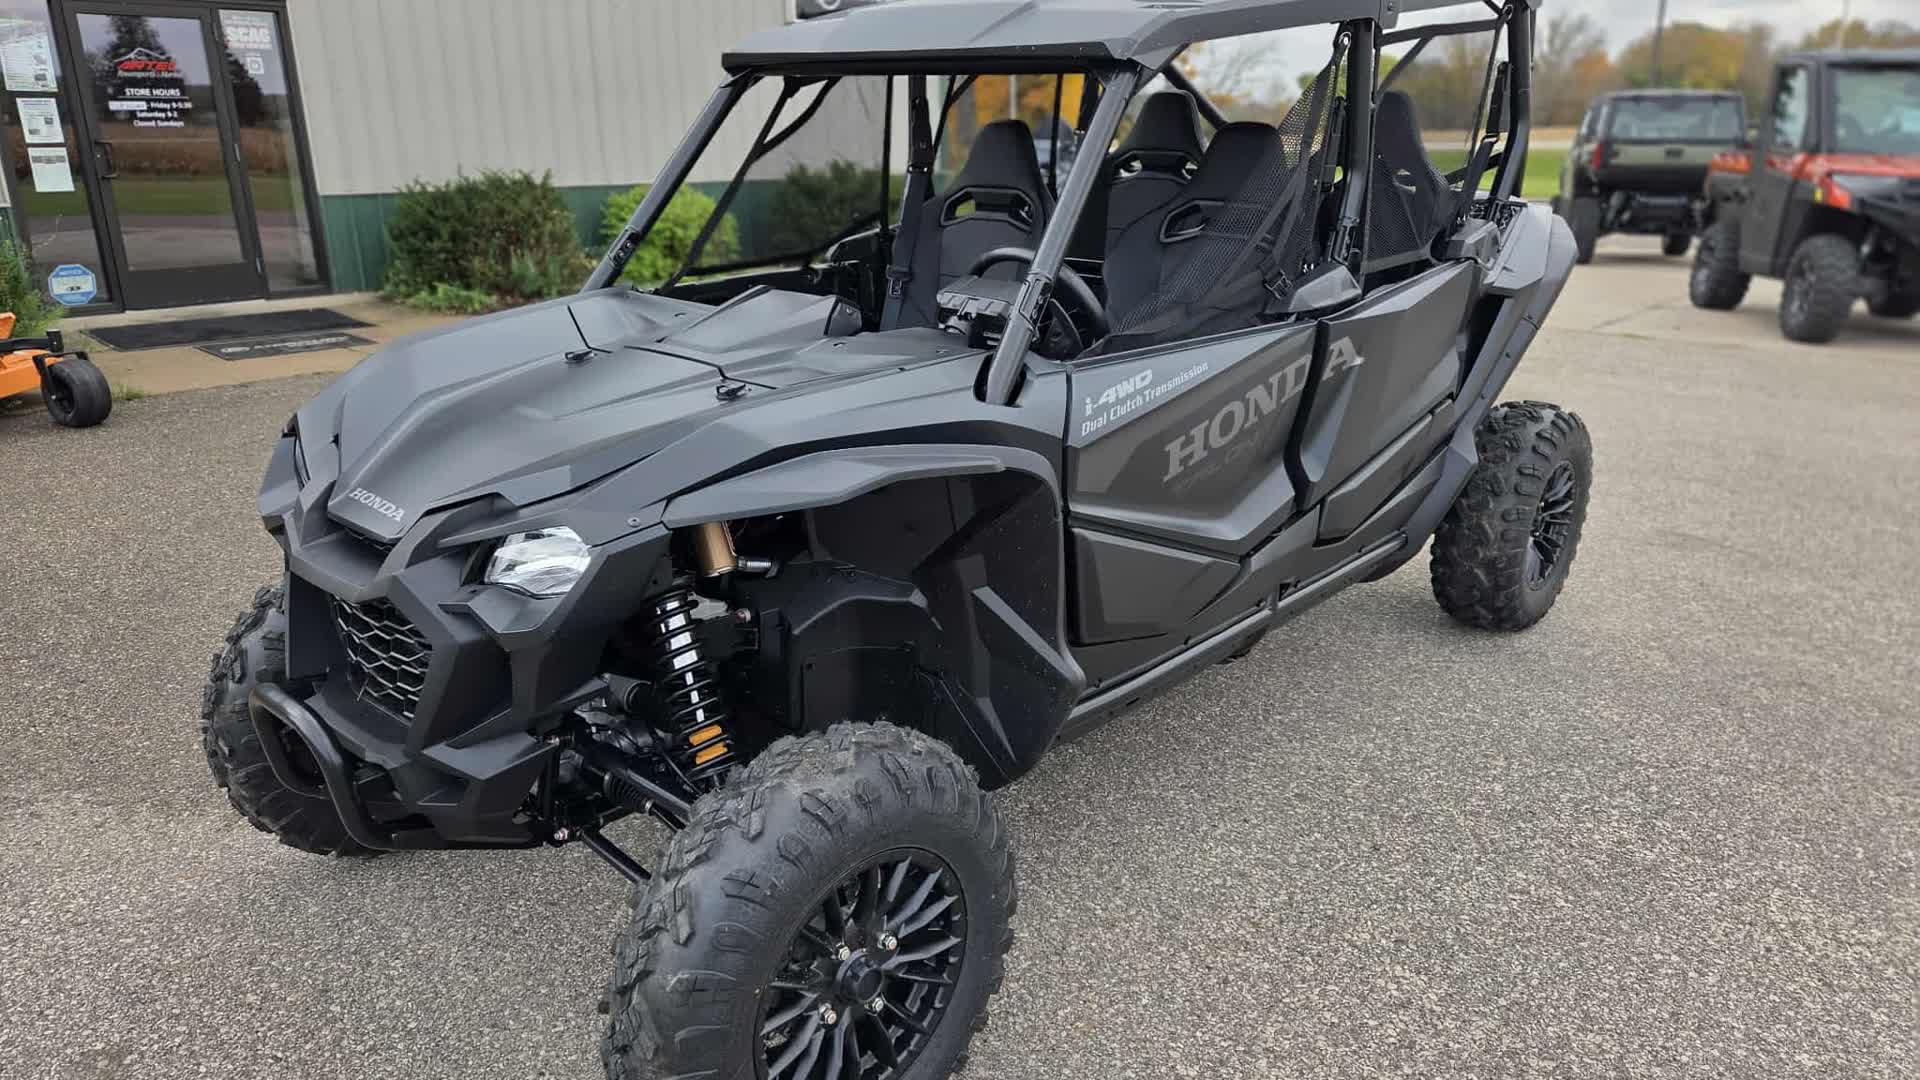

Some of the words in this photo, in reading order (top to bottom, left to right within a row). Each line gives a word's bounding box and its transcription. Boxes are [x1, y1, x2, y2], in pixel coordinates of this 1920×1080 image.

[125, 88, 151, 96] STORE
[152, 88, 181, 97] HOURS
[150, 101, 171, 109] Friday
[132, 120, 156, 128] Closed
[1081, 413, 1107, 437] Dual
[1109, 395, 1143, 421] Clutch
[1143, 361, 1209, 402] Transmission
[1085, 368, 1153, 416] i-4WD
[1162, 335, 1366, 483] HONDA
[348, 486, 406, 522] HONDA
